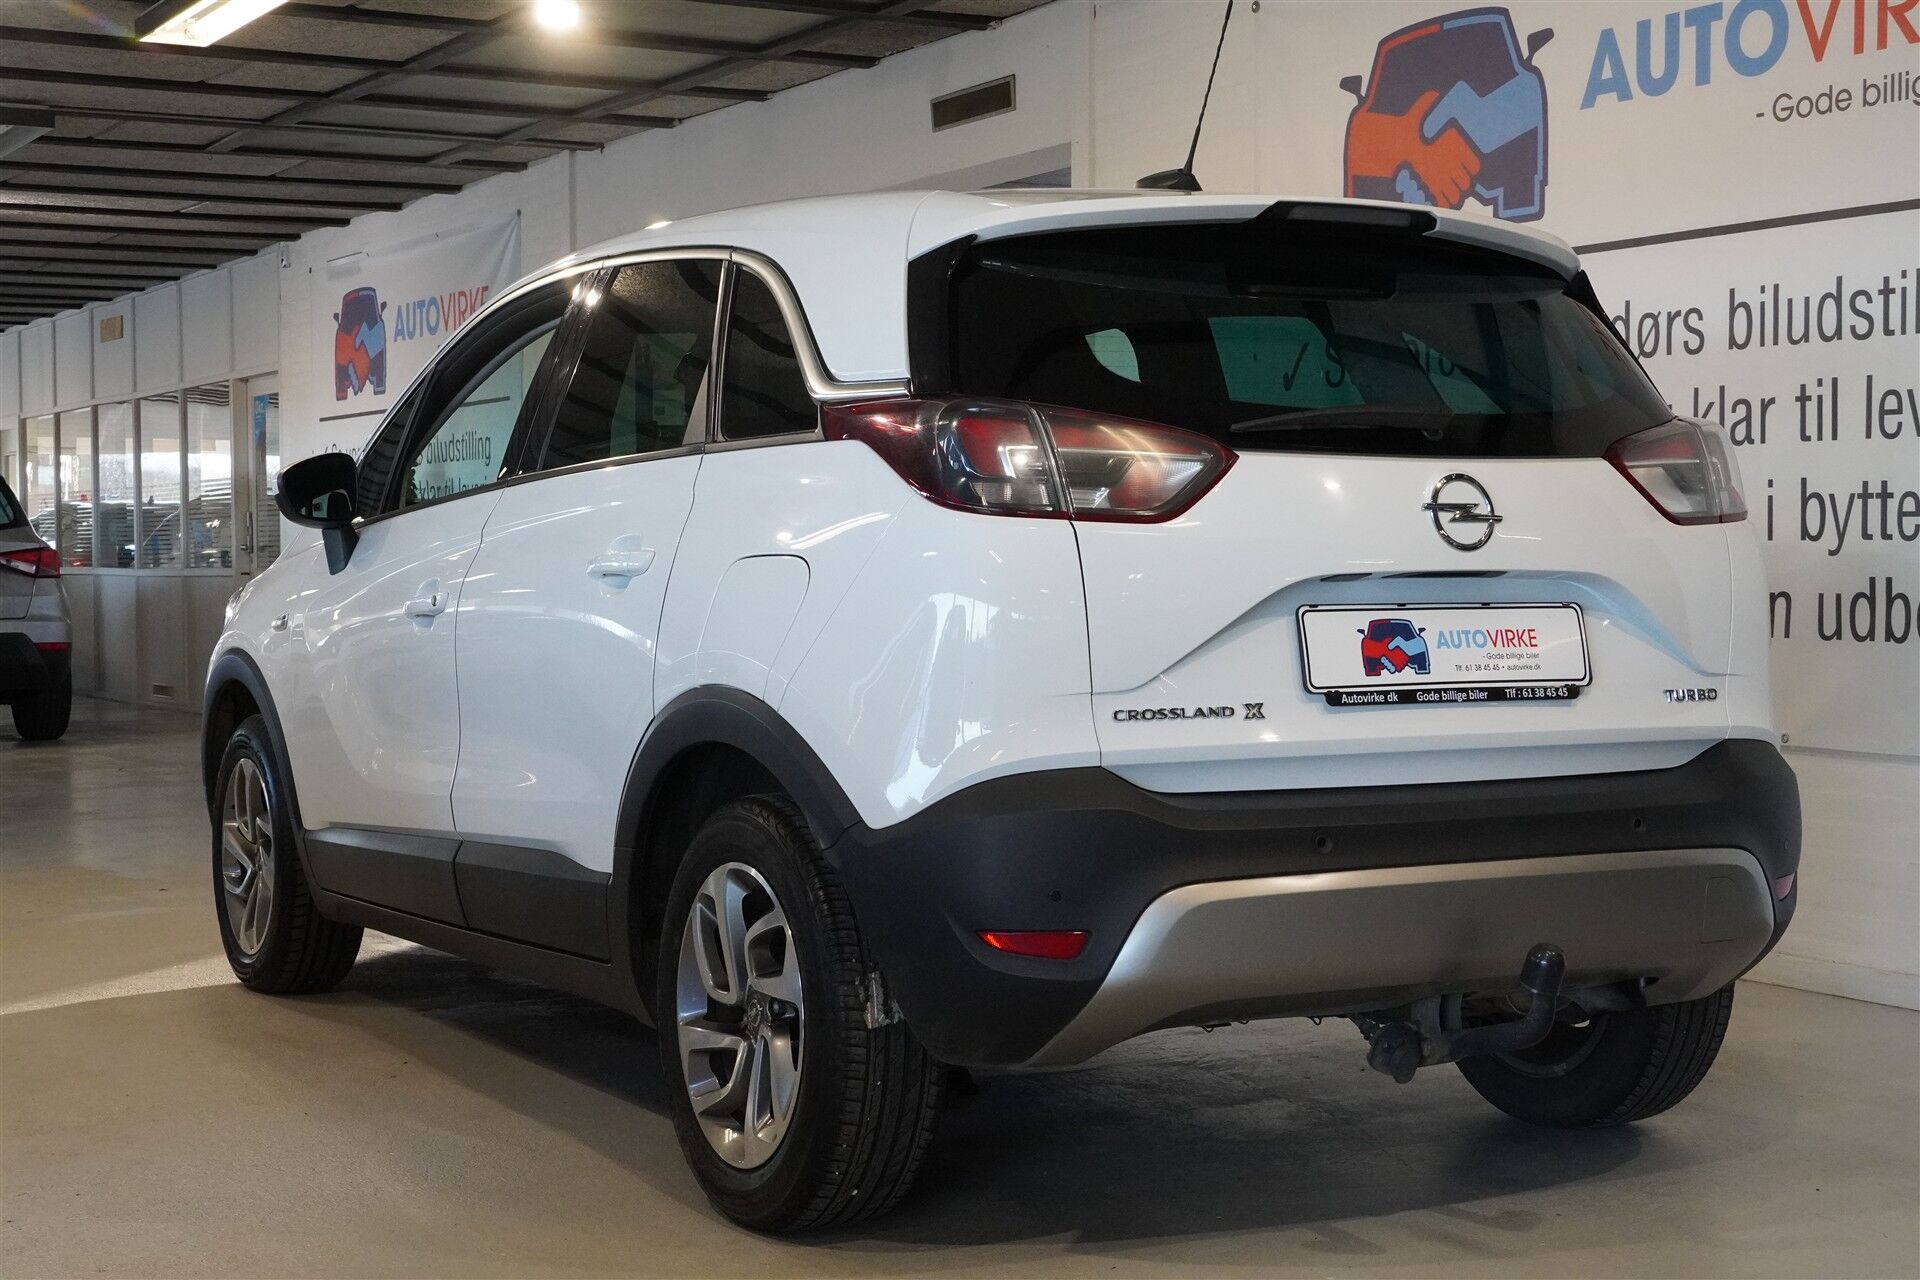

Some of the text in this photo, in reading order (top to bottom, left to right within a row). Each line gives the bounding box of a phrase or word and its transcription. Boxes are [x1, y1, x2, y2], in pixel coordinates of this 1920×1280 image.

[1773, 85, 1852, 122] Gode
[1795, 377, 1839, 442] til
[1767, 477, 1920, 556] i bytte
[1817, 576, 1920, 645] udb
[1437, 628, 1538, 649] AUTOVIRKE
[1486, 652, 1505, 660] Gode
[1341, 692, 1385, 704] Autovirke
[1387, 691, 1399, 702] dk
[1416, 690, 1440, 701] Gode
[1441, 690, 1467, 702] billige
[1468, 689, 1488, 699] biler
[1522, 688, 1533, 698] 61
[1534, 688, 1545, 697] 38
[1546, 687, 1557, 697] 45
[1557, 687, 1569, 697] 45
[1663, 688, 1718, 702] TURBO
[1113, 702, 1266, 721] CROSSLAND X
